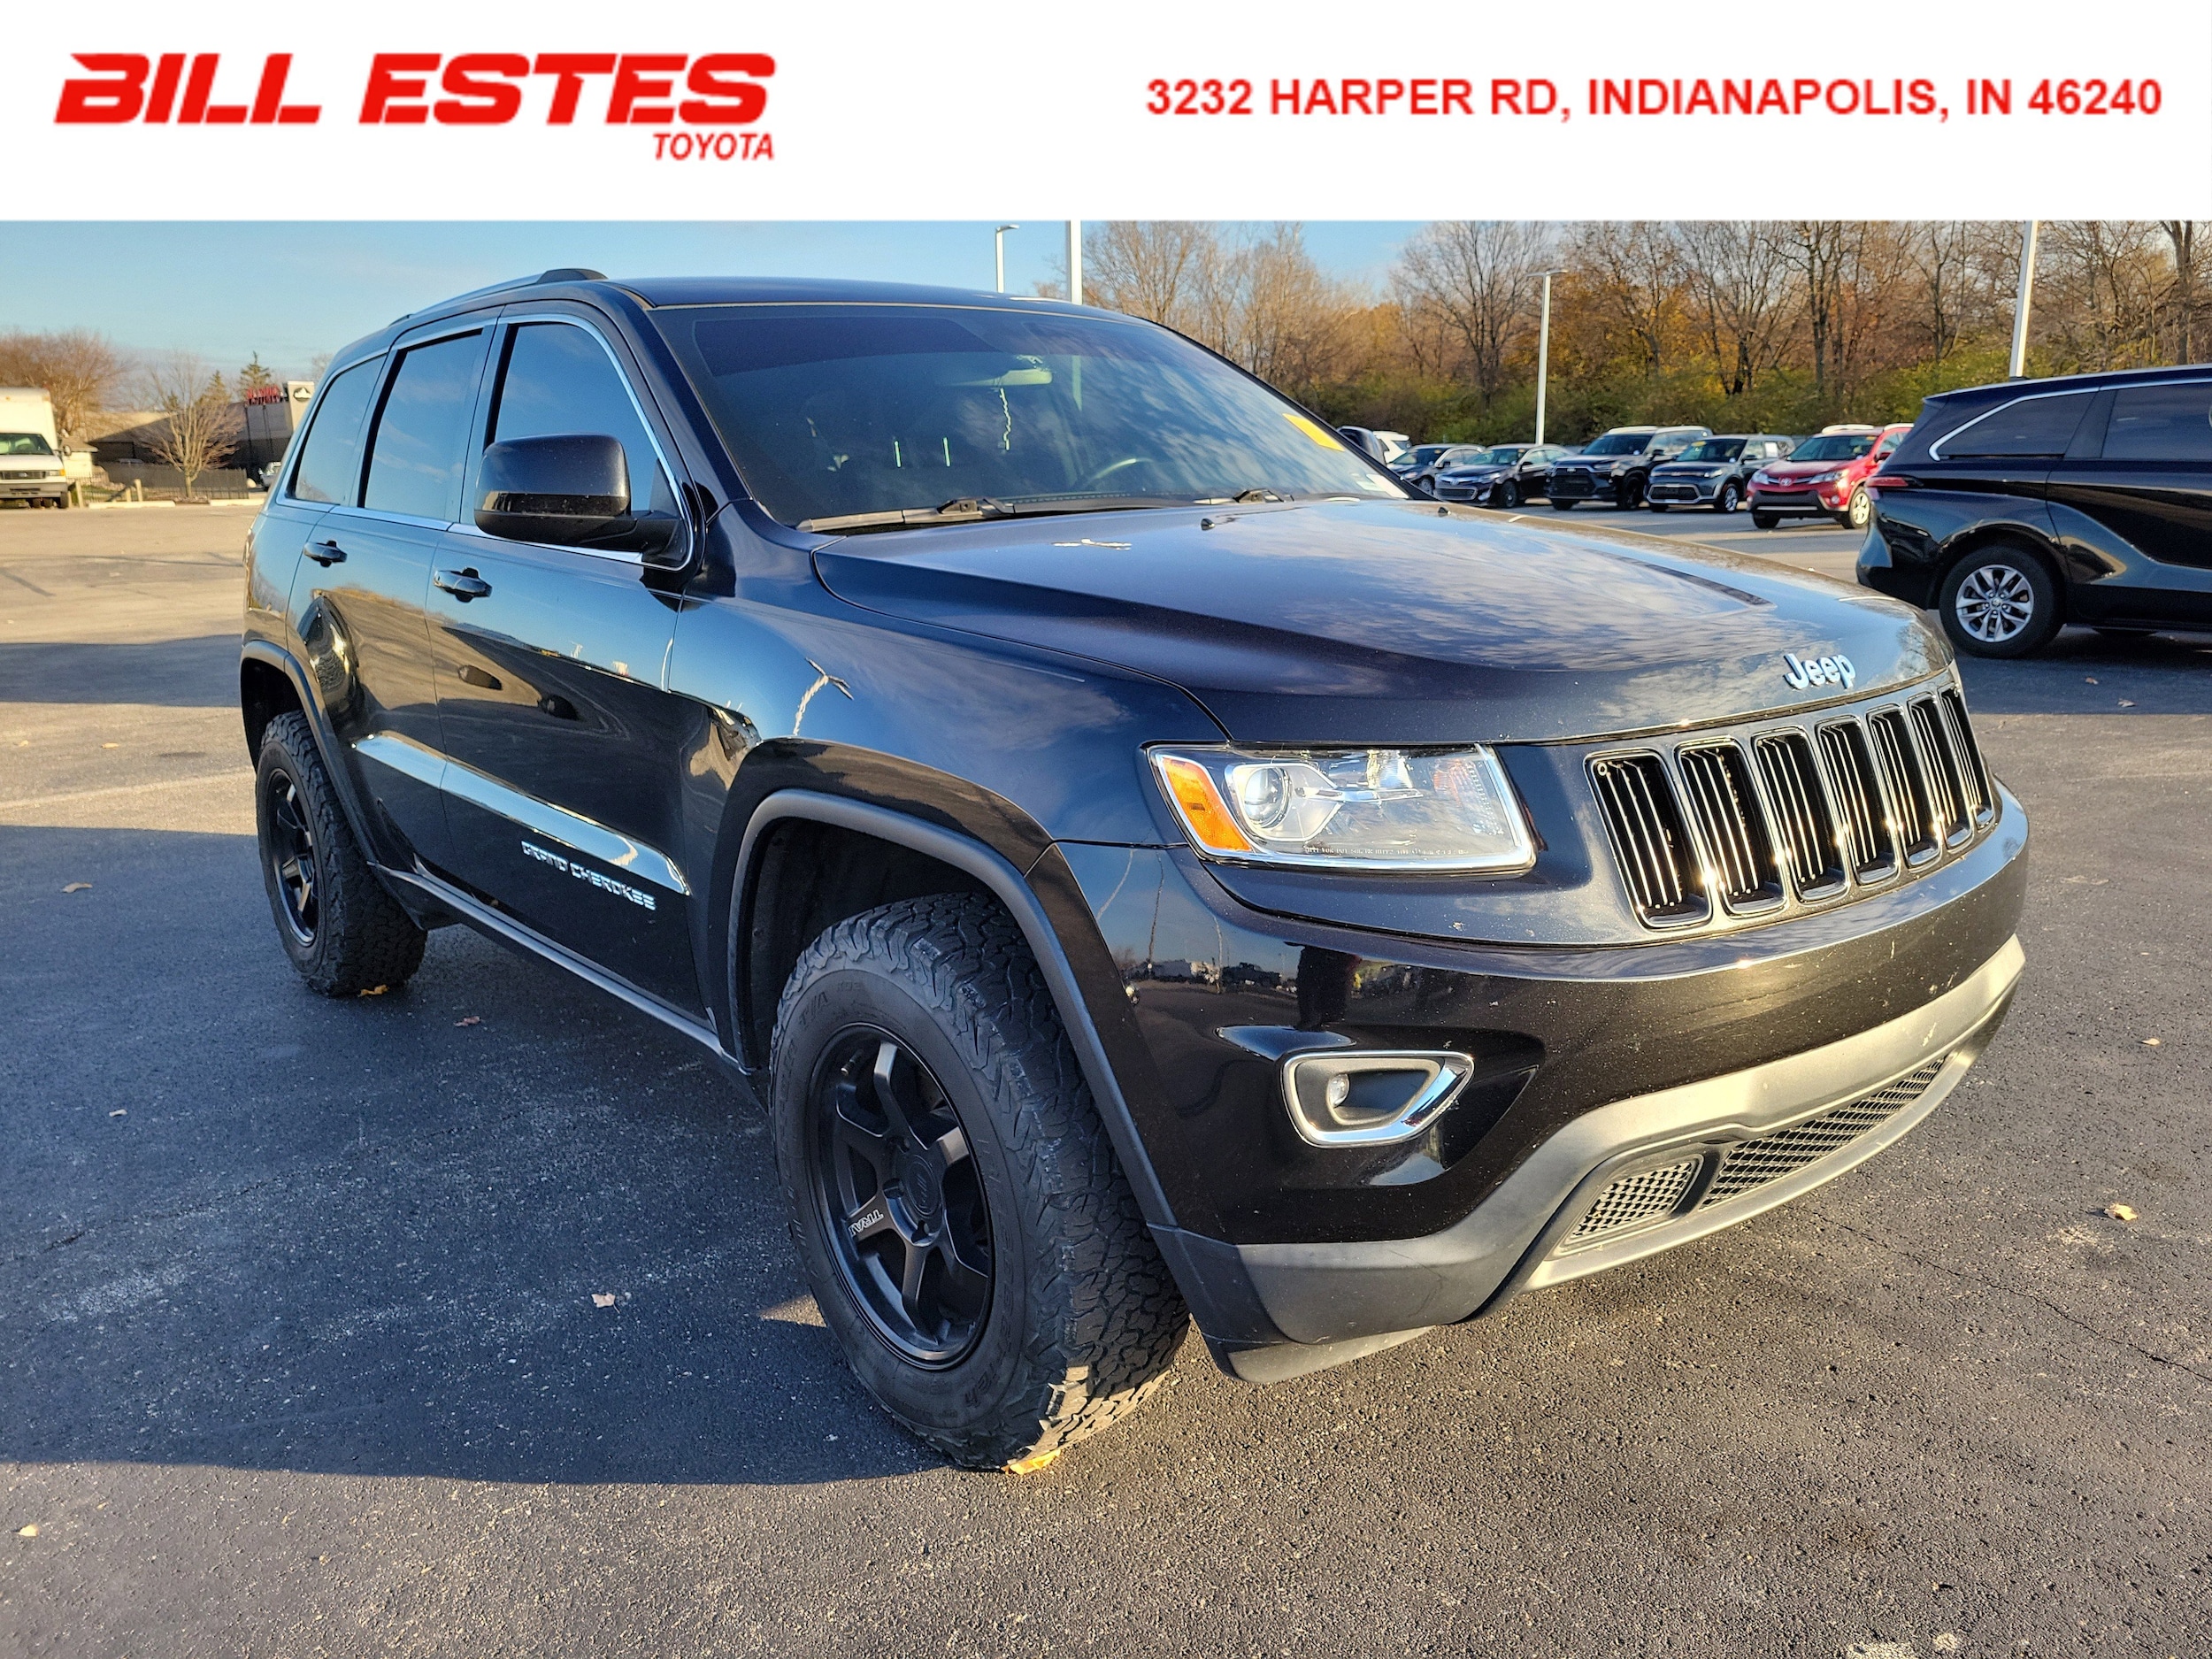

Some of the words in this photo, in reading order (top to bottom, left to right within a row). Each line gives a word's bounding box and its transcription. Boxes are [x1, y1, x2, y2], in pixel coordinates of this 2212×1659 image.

[1783, 652, 1856, 690] Jeep
[521, 841, 569, 872] GRAND
[570, 862, 657, 911] CHEROKEE
